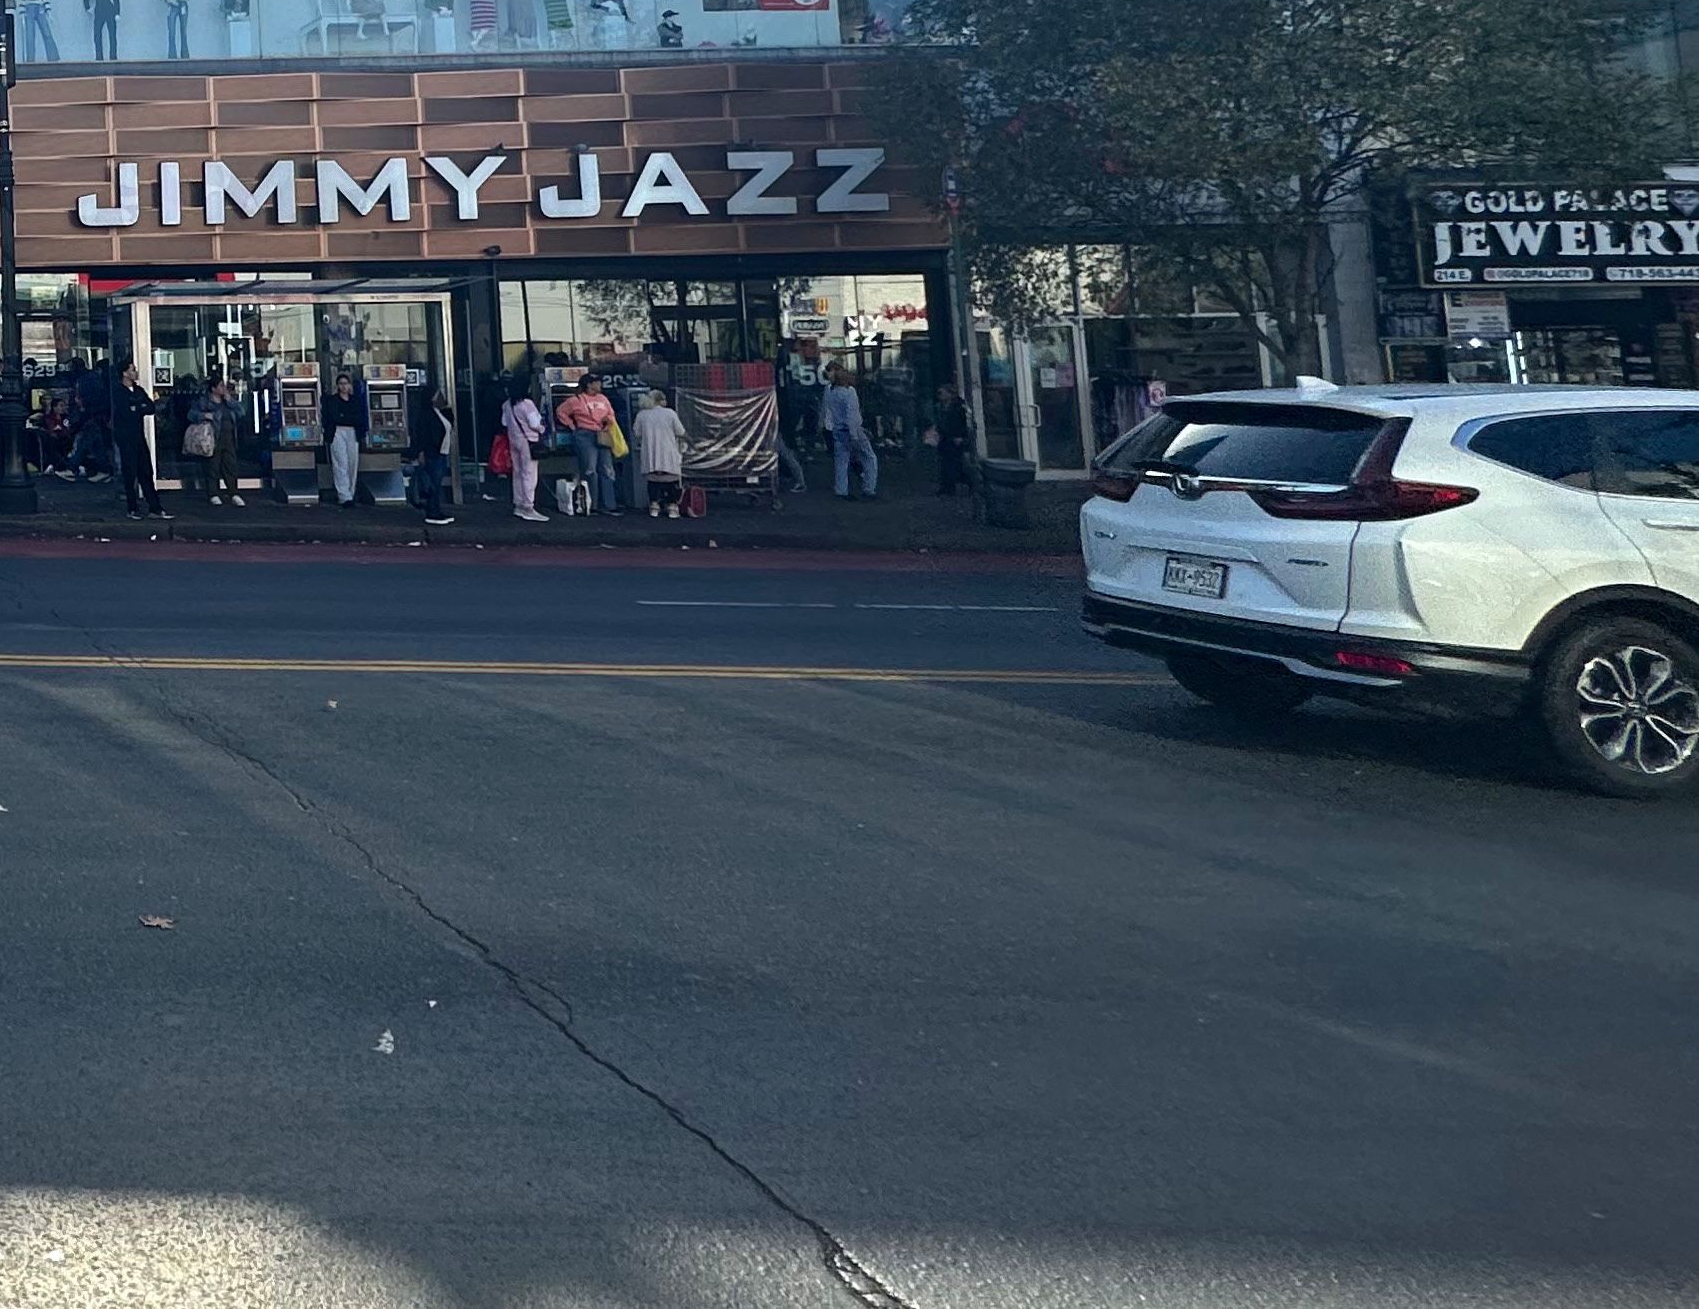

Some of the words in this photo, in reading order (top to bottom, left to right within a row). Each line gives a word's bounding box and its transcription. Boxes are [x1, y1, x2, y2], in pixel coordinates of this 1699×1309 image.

[77, 153, 507, 228] JIMMY
[539, 147, 891, 219] JAZZ
[1464, 190, 1545, 214] GOLD
[1433, 221, 1699, 266] JEWELRY
[1436, 270, 1457, 281] 214
